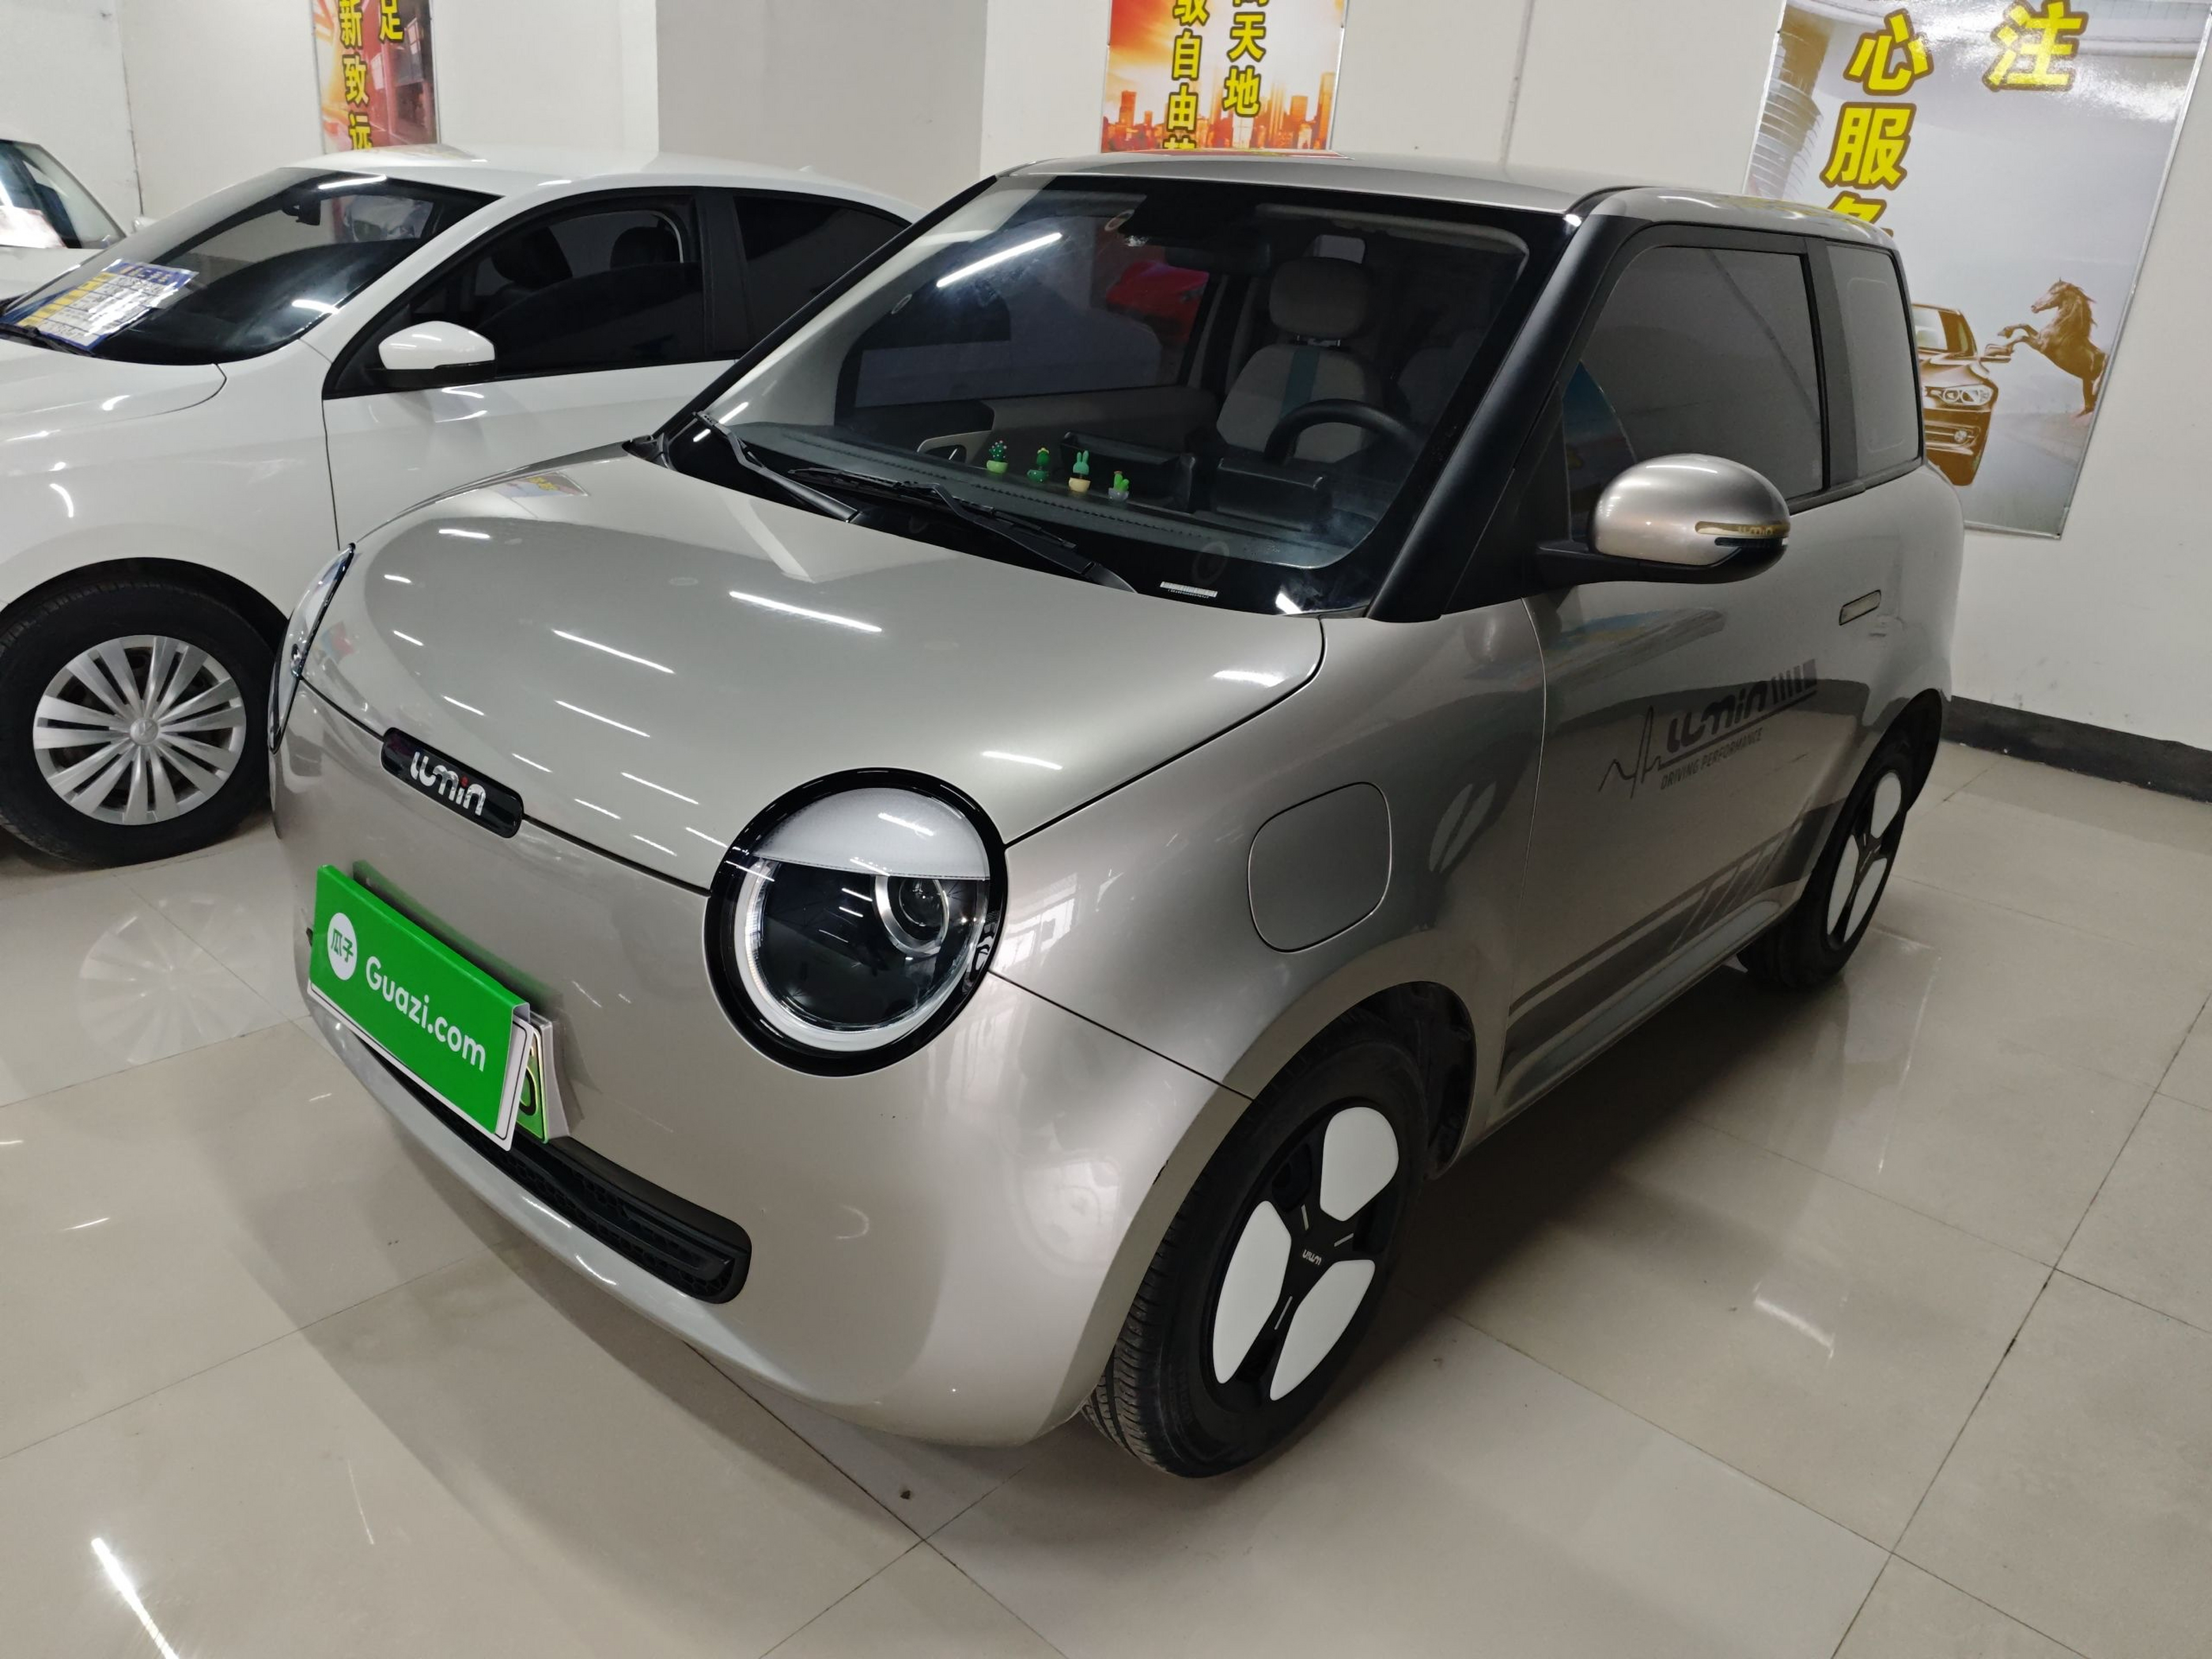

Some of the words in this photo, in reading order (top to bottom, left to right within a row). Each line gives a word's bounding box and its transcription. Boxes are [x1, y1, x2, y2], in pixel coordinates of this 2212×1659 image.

[1164, 0, 1209, 149] 自由
[1224, 0, 1268, 116] 天地
[1986, 1, 2085, 89] 注
[410, 751, 486, 816] lumin
[1660, 758, 1700, 790] DRIVING
[1701, 728, 1763, 768] PERFORMANCE
[331, 928, 354, 963] 瓜子
[365, 956, 486, 1072] Guazi.com
